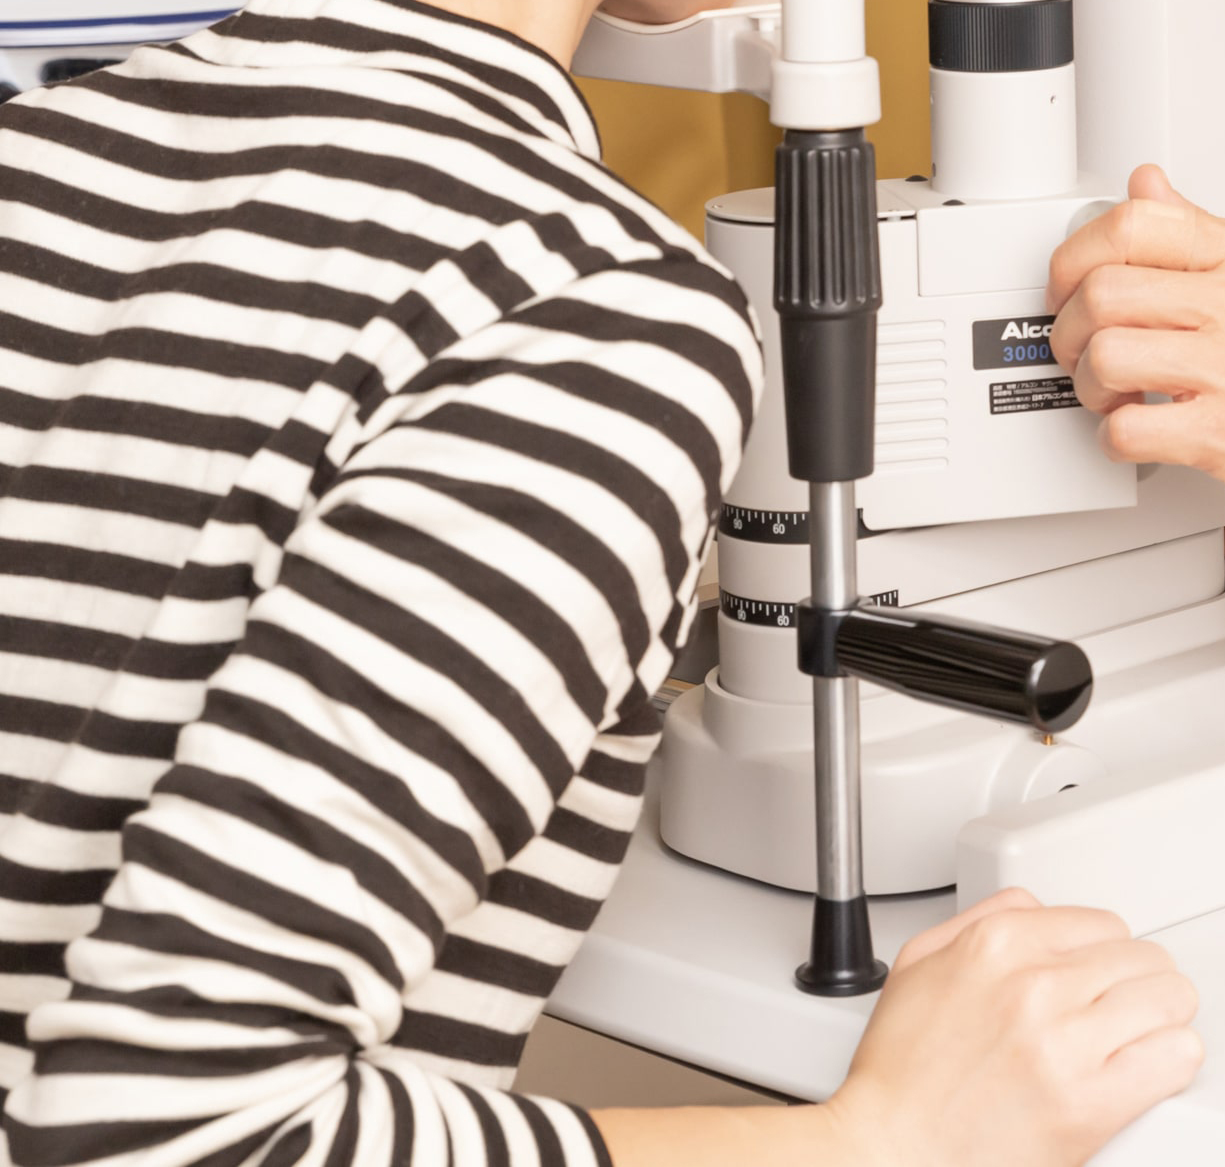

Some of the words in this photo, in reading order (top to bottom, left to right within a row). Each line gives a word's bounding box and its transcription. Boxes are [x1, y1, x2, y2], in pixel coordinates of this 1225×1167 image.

[1000, 321, 1054, 340] Alco
[733, 518, 743, 530] 90
[773, 523, 785, 534] 60
[737, 610, 746, 621] 90
[777, 615, 789, 626] 60
